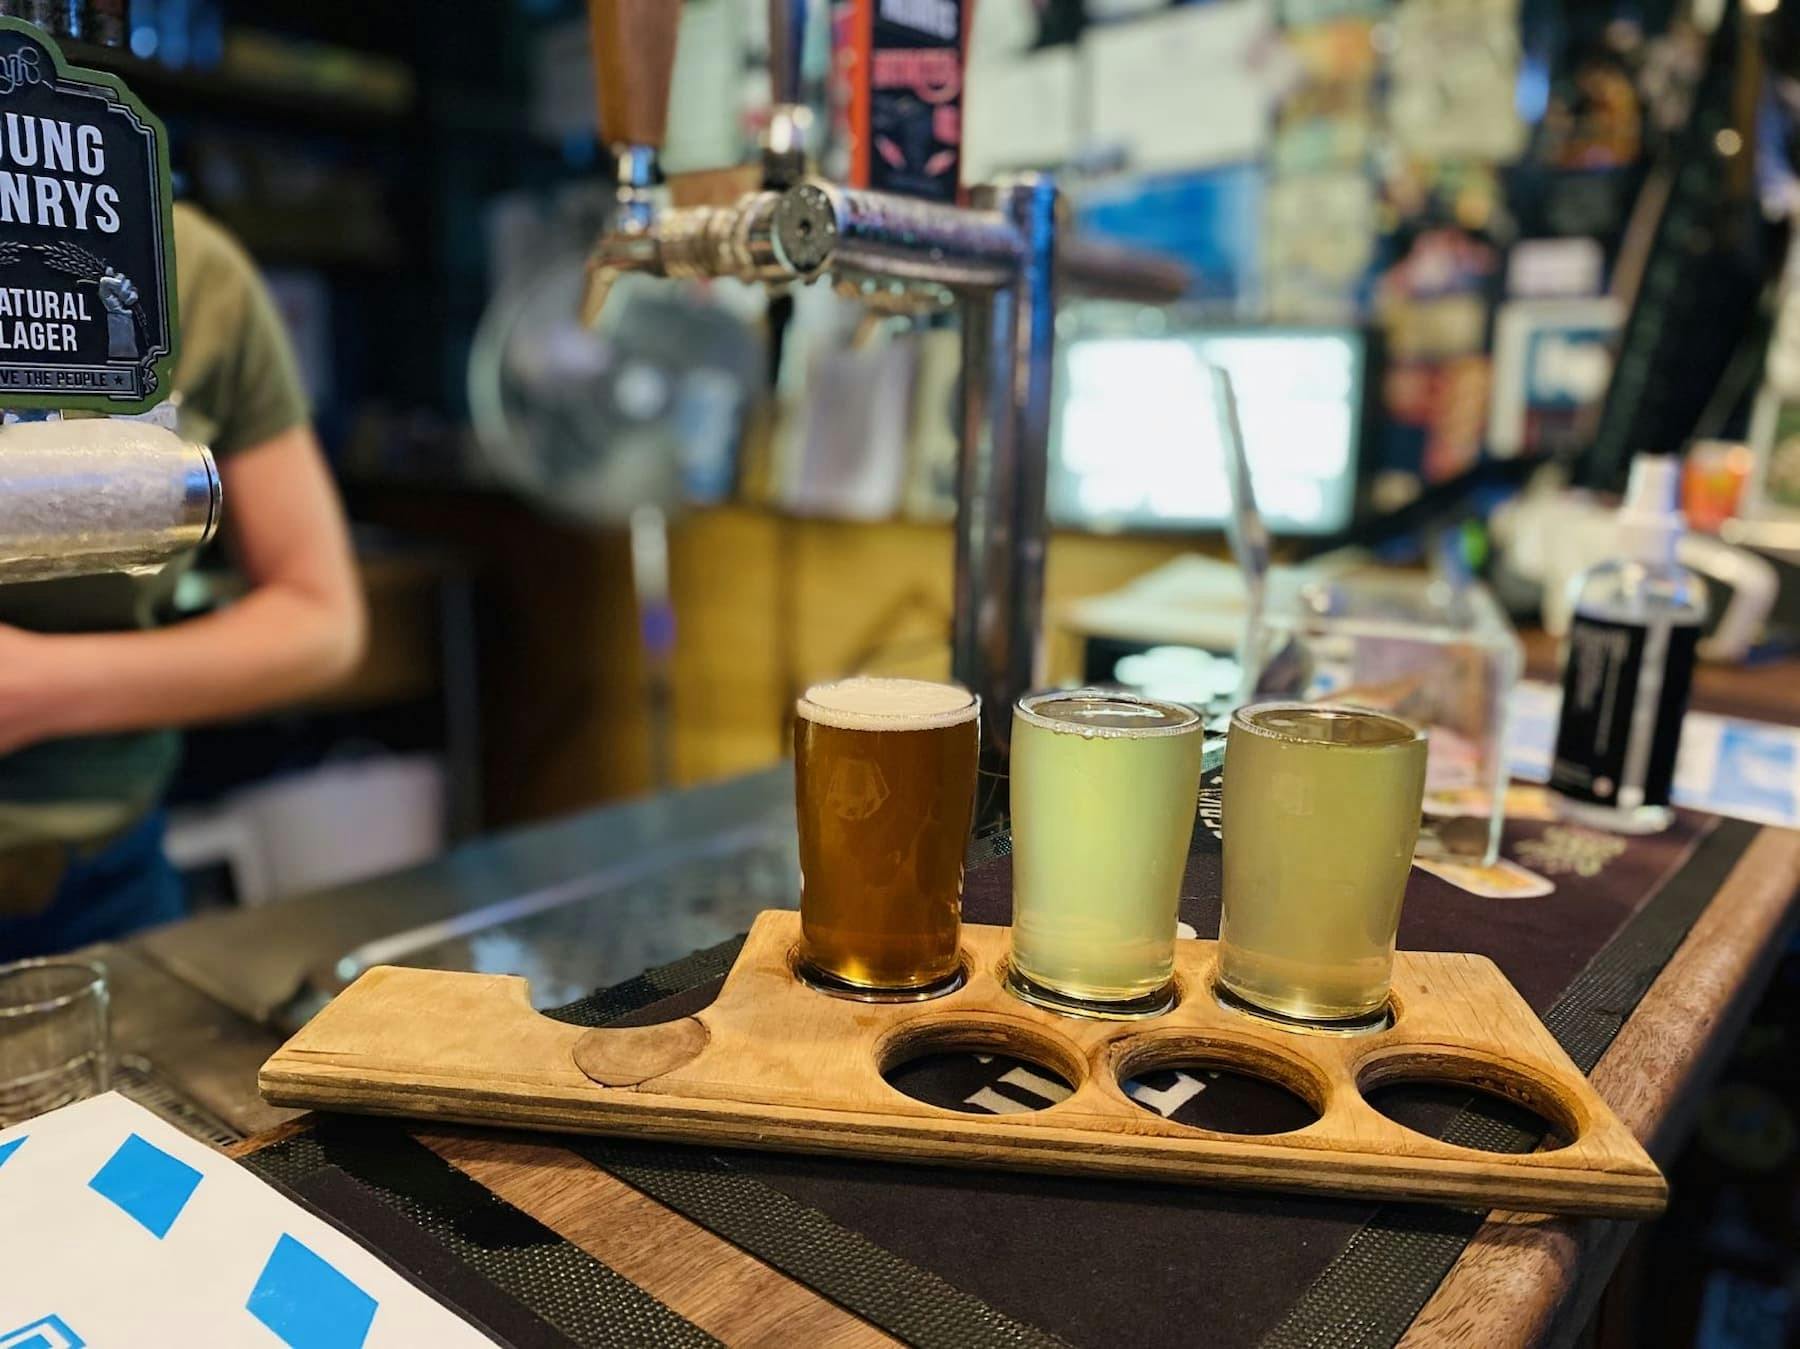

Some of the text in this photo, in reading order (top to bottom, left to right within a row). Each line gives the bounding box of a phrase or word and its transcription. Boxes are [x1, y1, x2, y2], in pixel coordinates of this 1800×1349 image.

[0, 112, 105, 176] UNG
[0, 170, 120, 233] NRYS
[0, 287, 92, 321] ATURAL
[0, 320, 78, 352] LAGER
[24, 371, 52, 386] THE
[56, 371, 109, 387] PEOPLE
